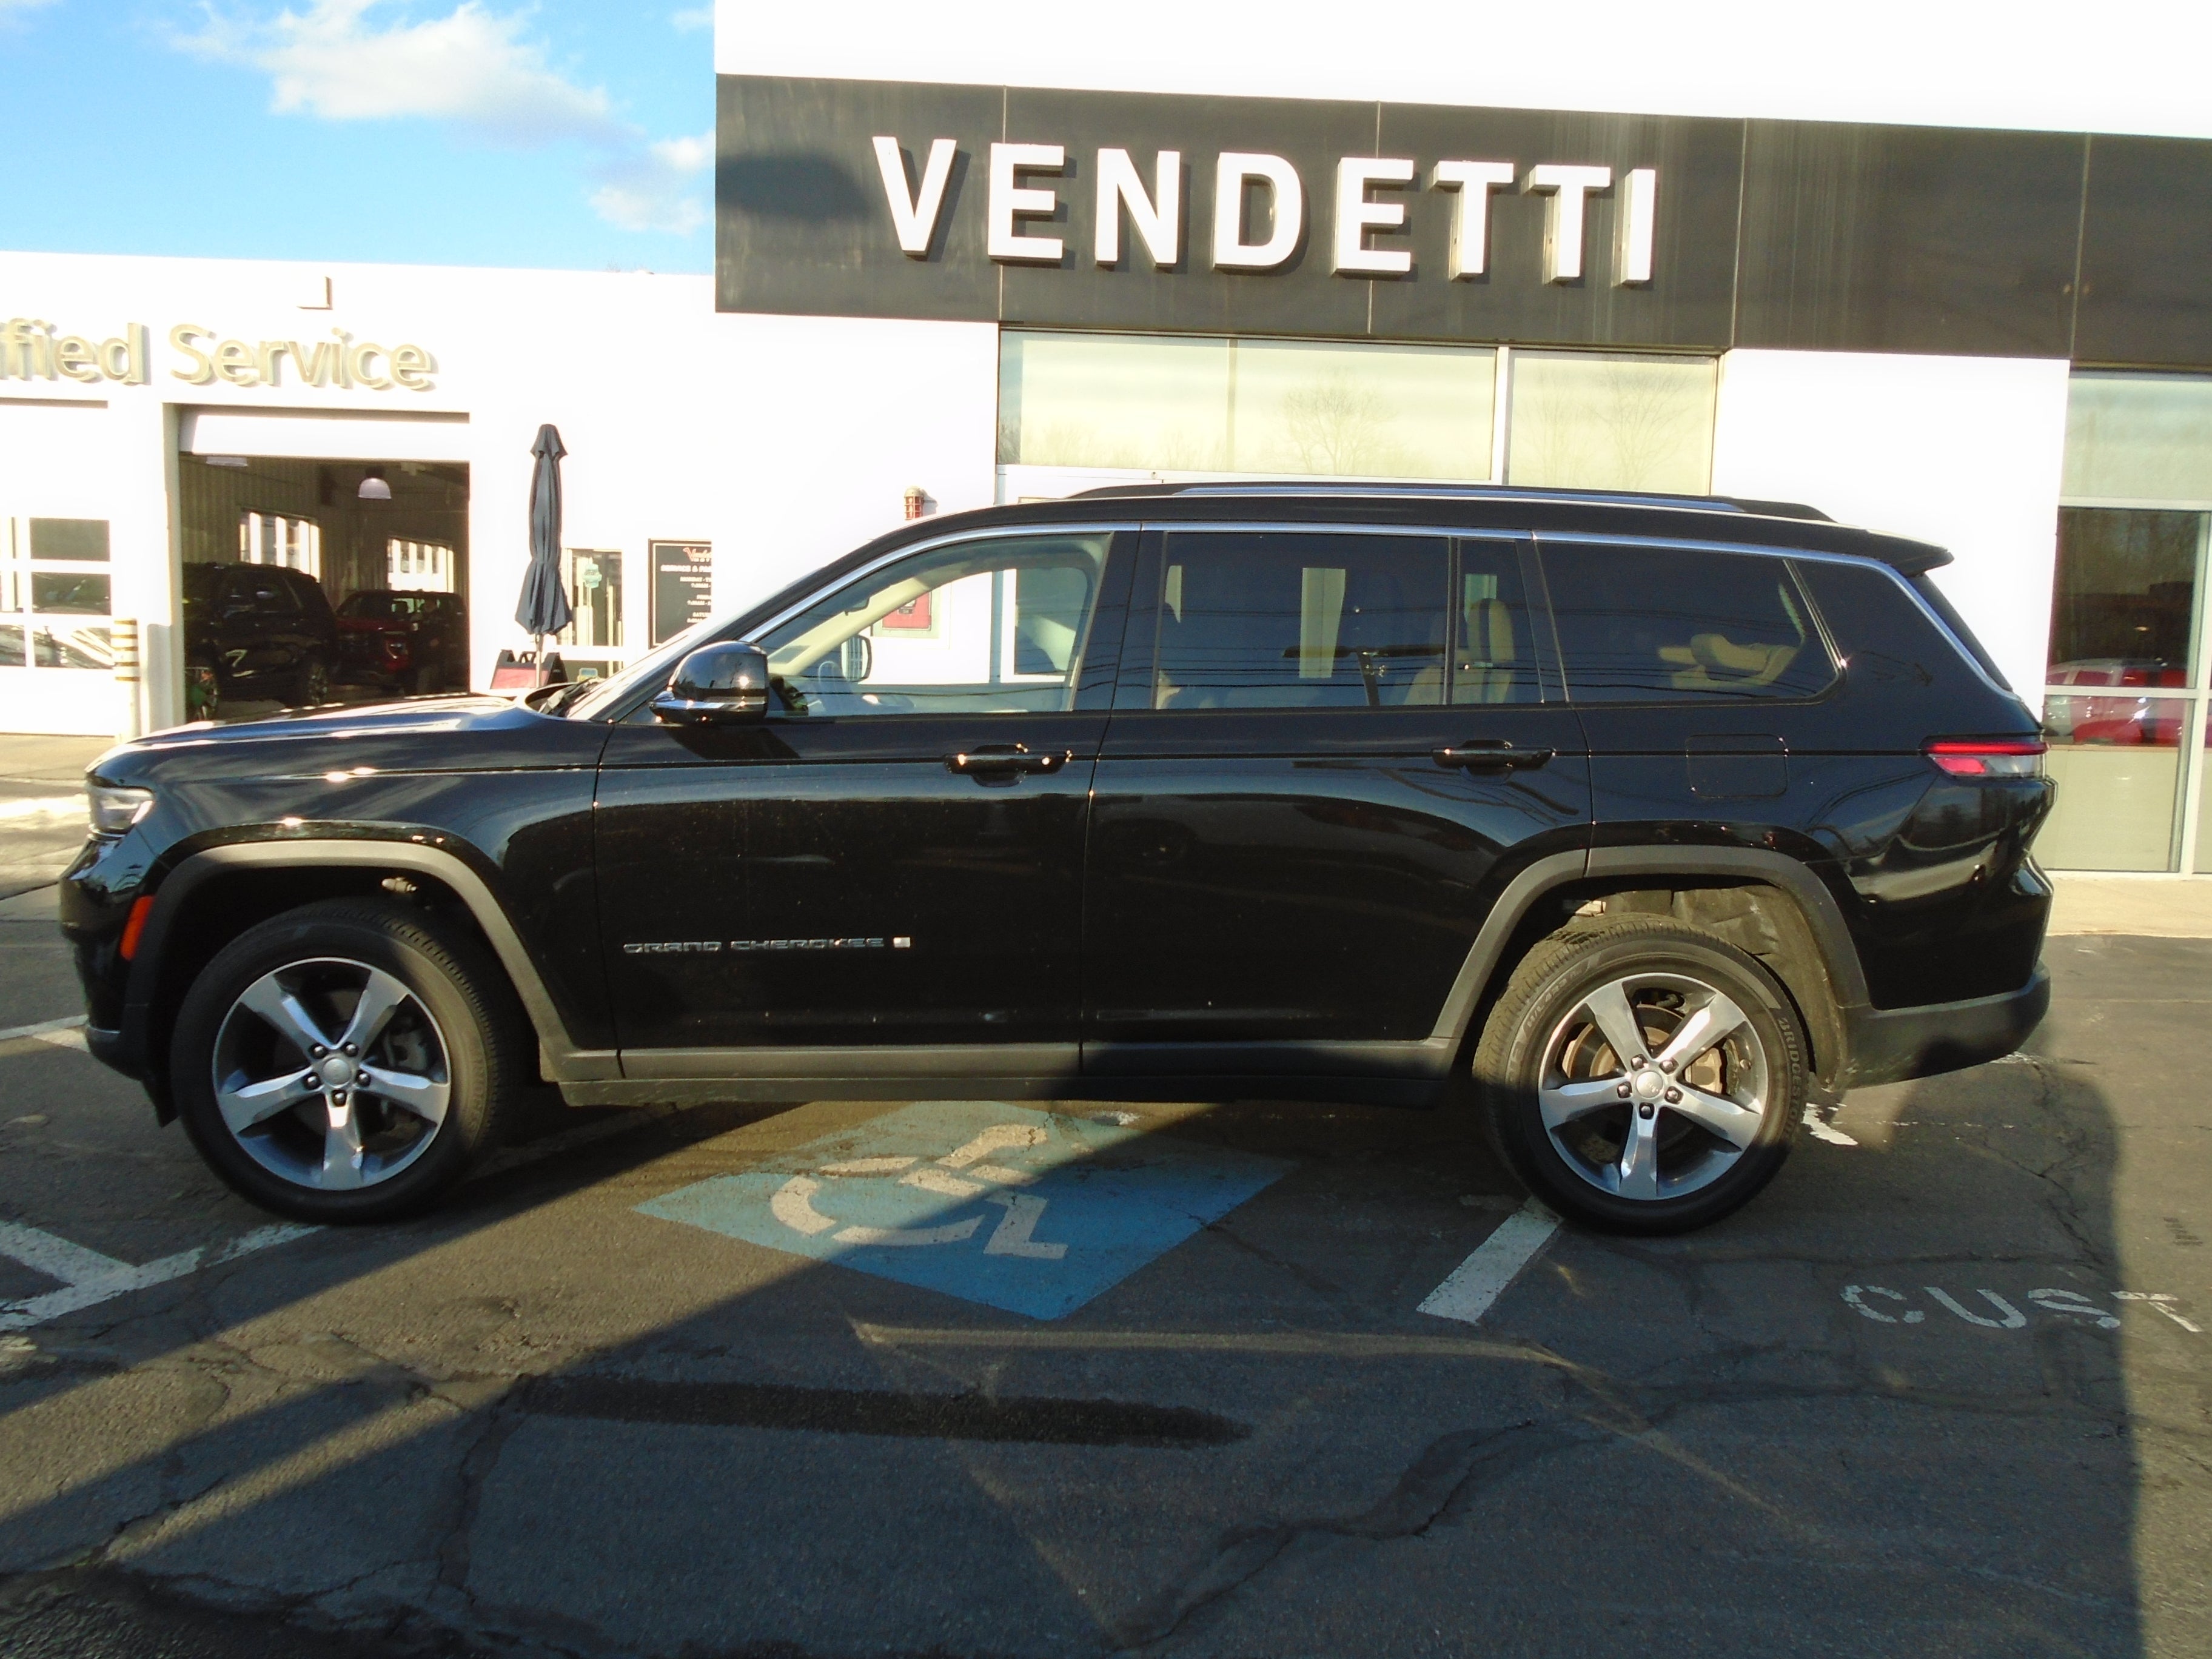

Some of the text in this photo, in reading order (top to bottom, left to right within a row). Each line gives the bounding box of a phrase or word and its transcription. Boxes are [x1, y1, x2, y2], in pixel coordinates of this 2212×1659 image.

[872, 136, 1656, 285] VENDETTI
[0, 318, 437, 390] fied Service
[623, 941, 722, 953] GRAND
[731, 938, 884, 950] CHEROKEE
[1840, 1284, 2204, 1333] CUST
